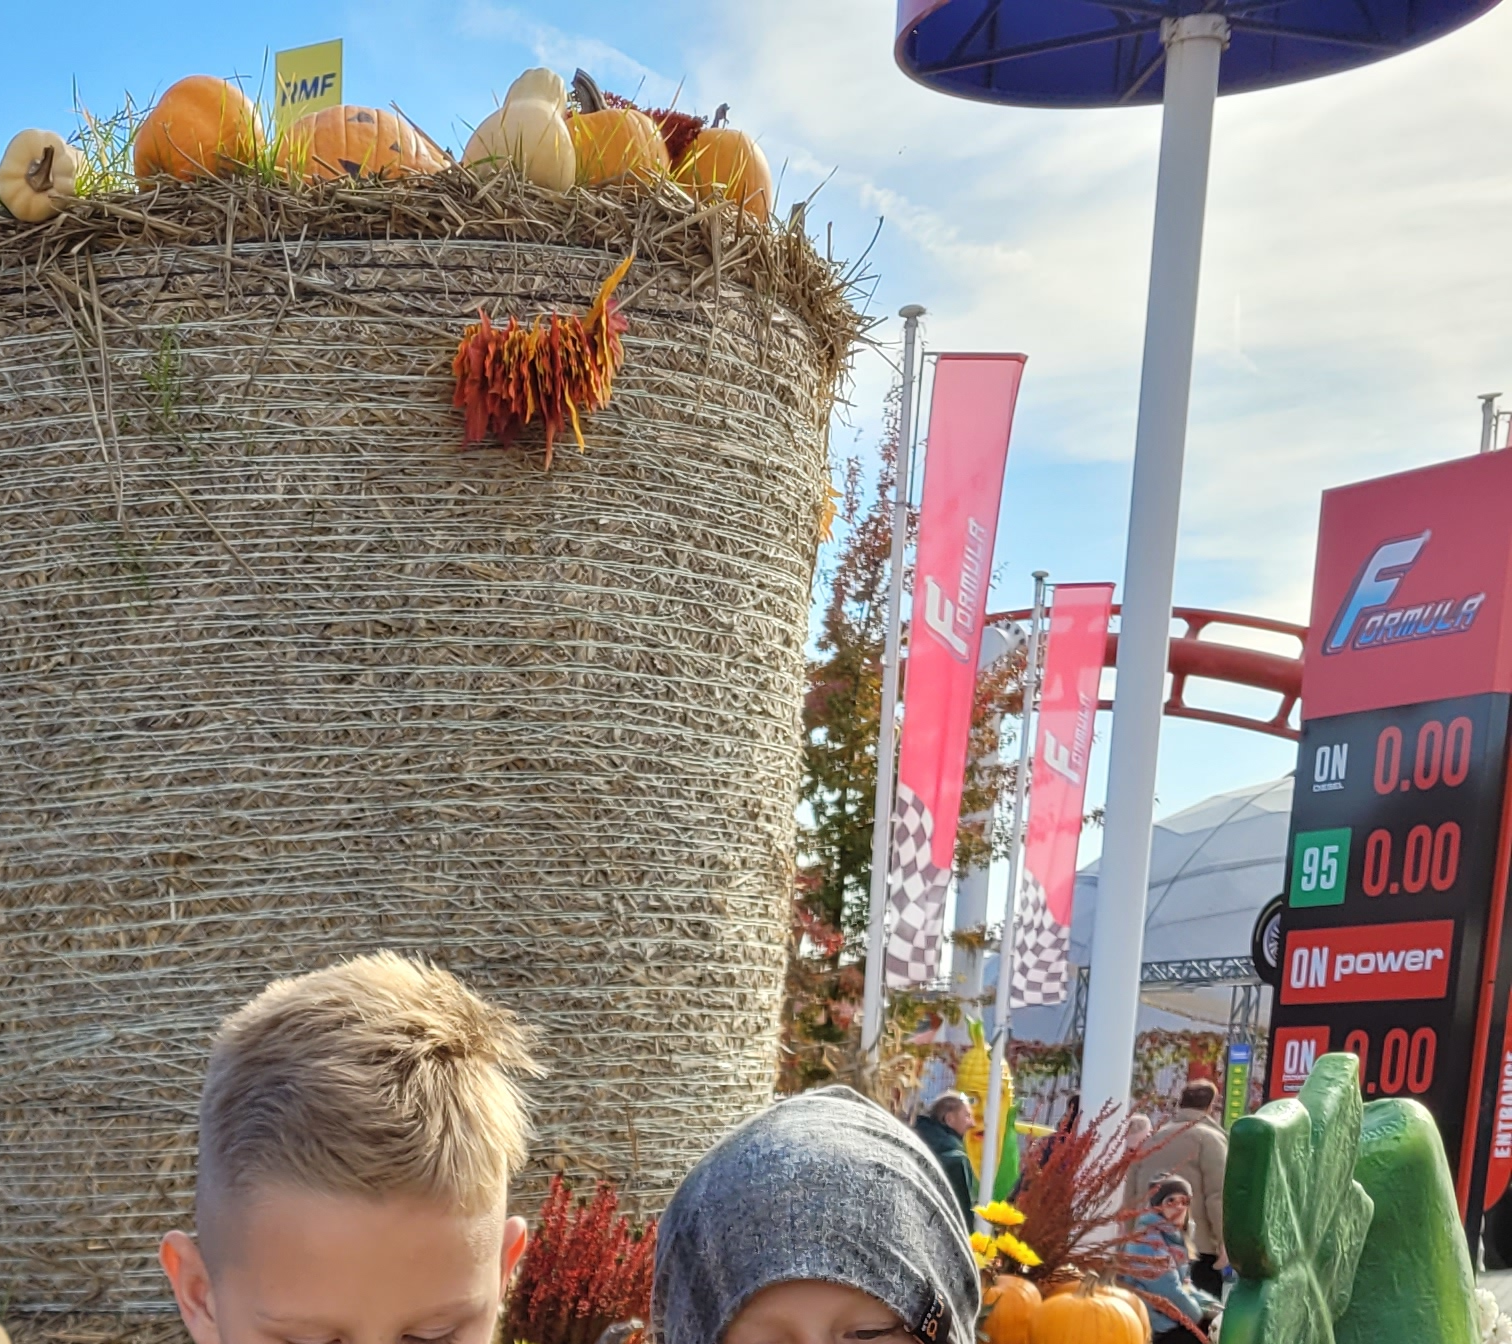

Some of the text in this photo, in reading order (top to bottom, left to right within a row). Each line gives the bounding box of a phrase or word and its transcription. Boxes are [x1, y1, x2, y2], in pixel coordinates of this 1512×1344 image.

[281, 72, 336, 107] RMF
[924, 516, 986, 663] FORMULA
[1323, 529, 1486, 656] FORMULA
[1043, 691, 1092, 785] FORMULA
[1313, 716, 1473, 795] ON 0.00
[1301, 821, 1461, 897] 95 0.00
[1290, 946, 1444, 989] ON power
[1284, 1039, 1317, 1074] ON
